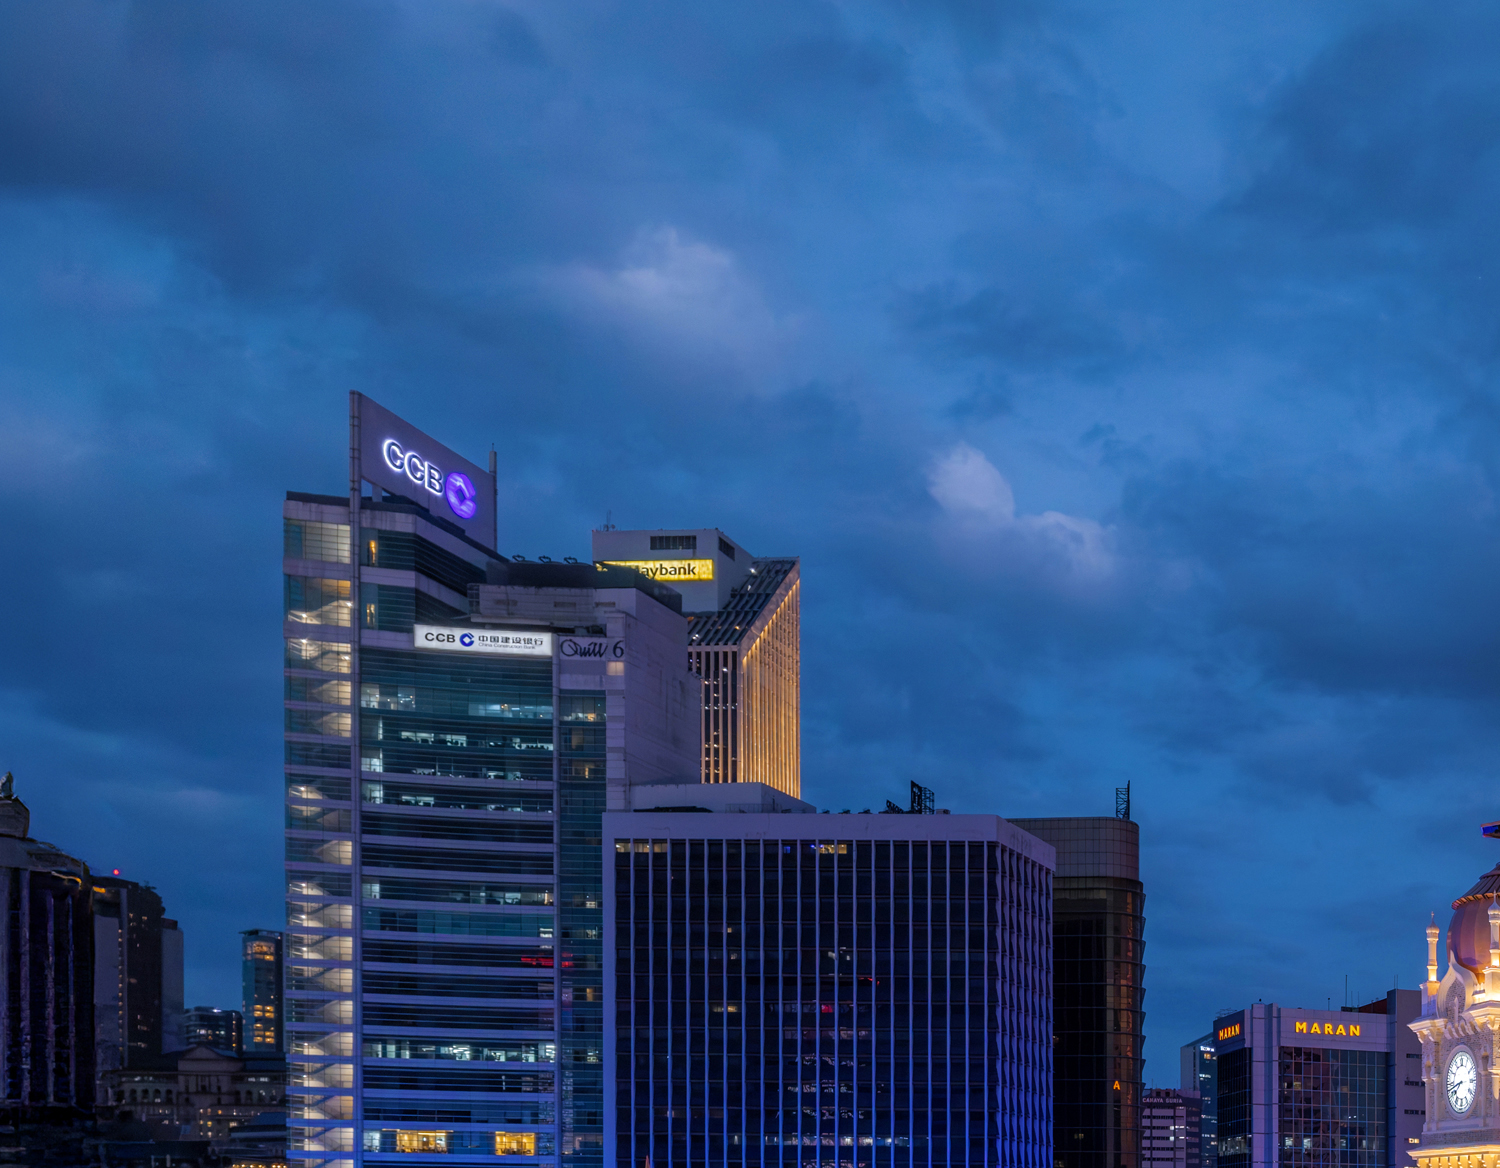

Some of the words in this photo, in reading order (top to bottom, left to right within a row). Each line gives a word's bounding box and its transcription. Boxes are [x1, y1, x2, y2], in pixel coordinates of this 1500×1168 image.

[383, 438, 444, 496] CCB
[640, 562, 697, 579] aybank
[424, 632, 456, 643] CCB
[478, 635, 544, 646] 中国建设银行
[560, 639, 608, 658] Quill
[613, 640, 625, 658] 6
[1218, 1023, 1240, 1041] MARAN
[1295, 1021, 1361, 1037] MARAN
[1113, 1080, 1121, 1090] A
